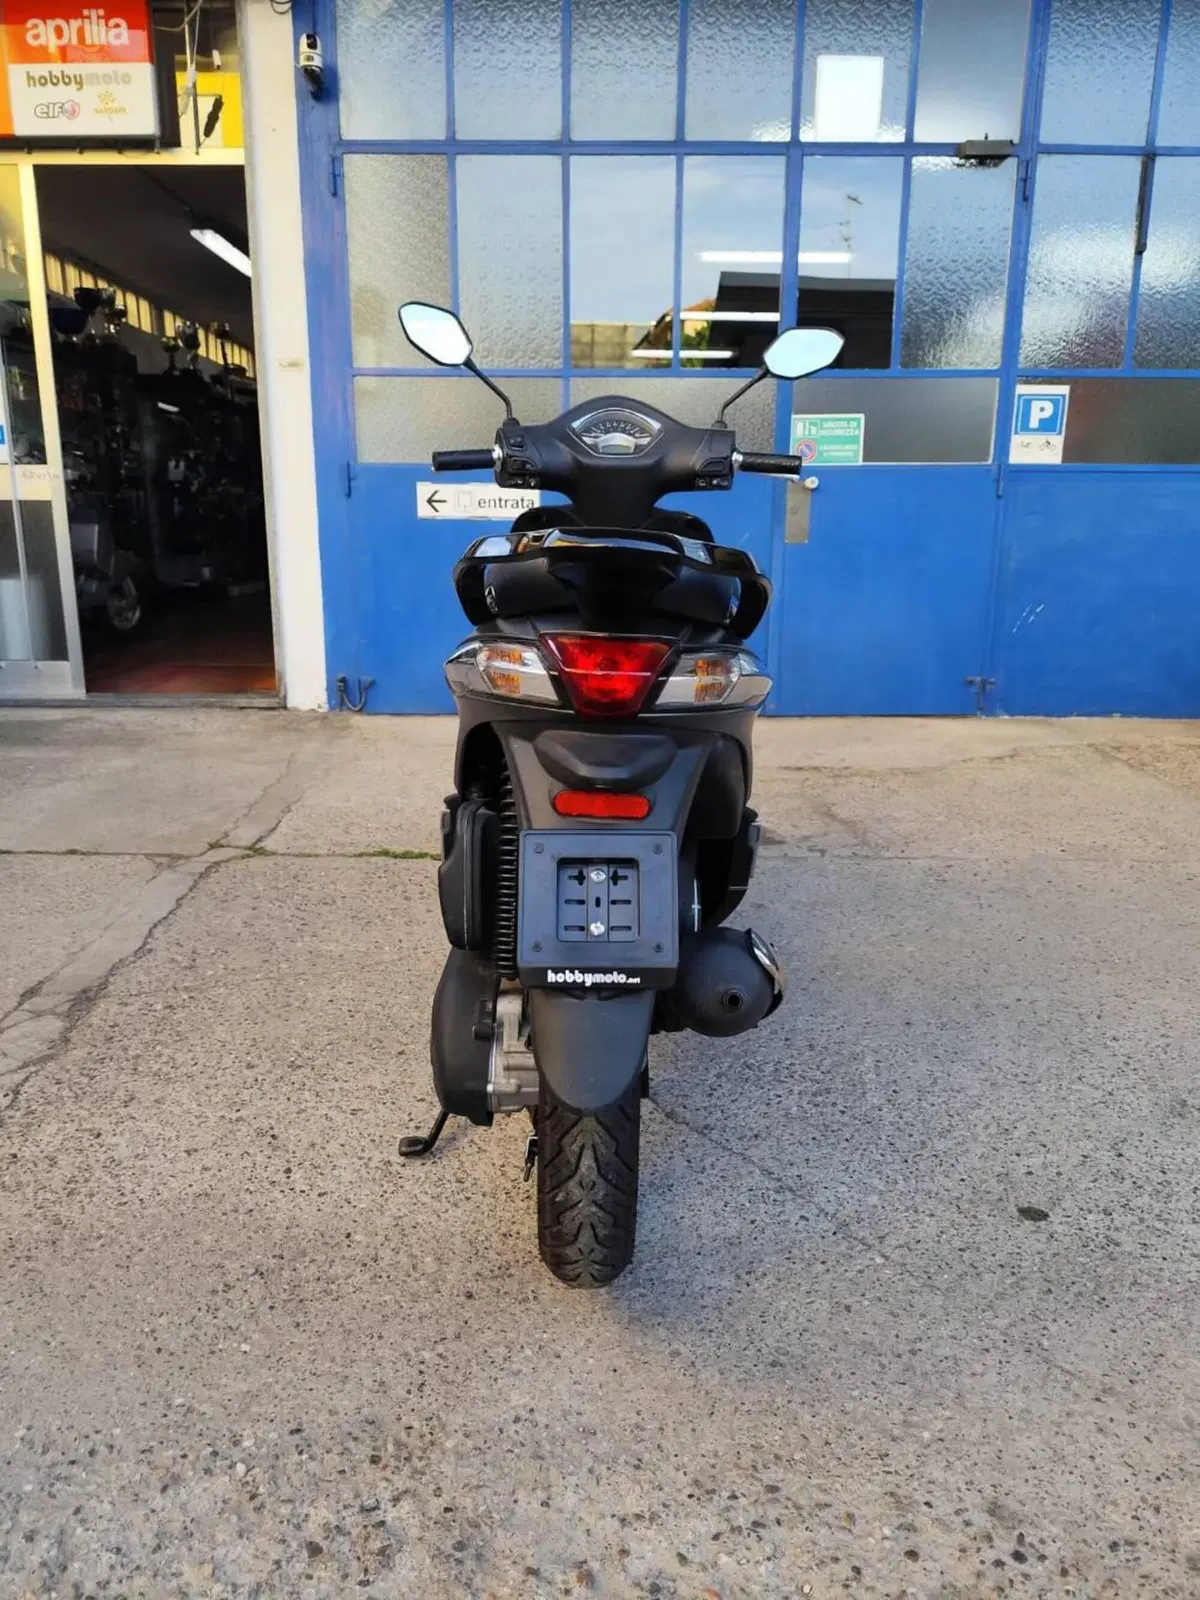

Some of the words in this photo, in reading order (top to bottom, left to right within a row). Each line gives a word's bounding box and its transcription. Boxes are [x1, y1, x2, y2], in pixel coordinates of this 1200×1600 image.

[26, 9, 129, 52] aprilia
[26, 70, 133, 91] hobbymoto
[1029, 400, 1054, 429] P
[478, 496, 535, 509] entrata
